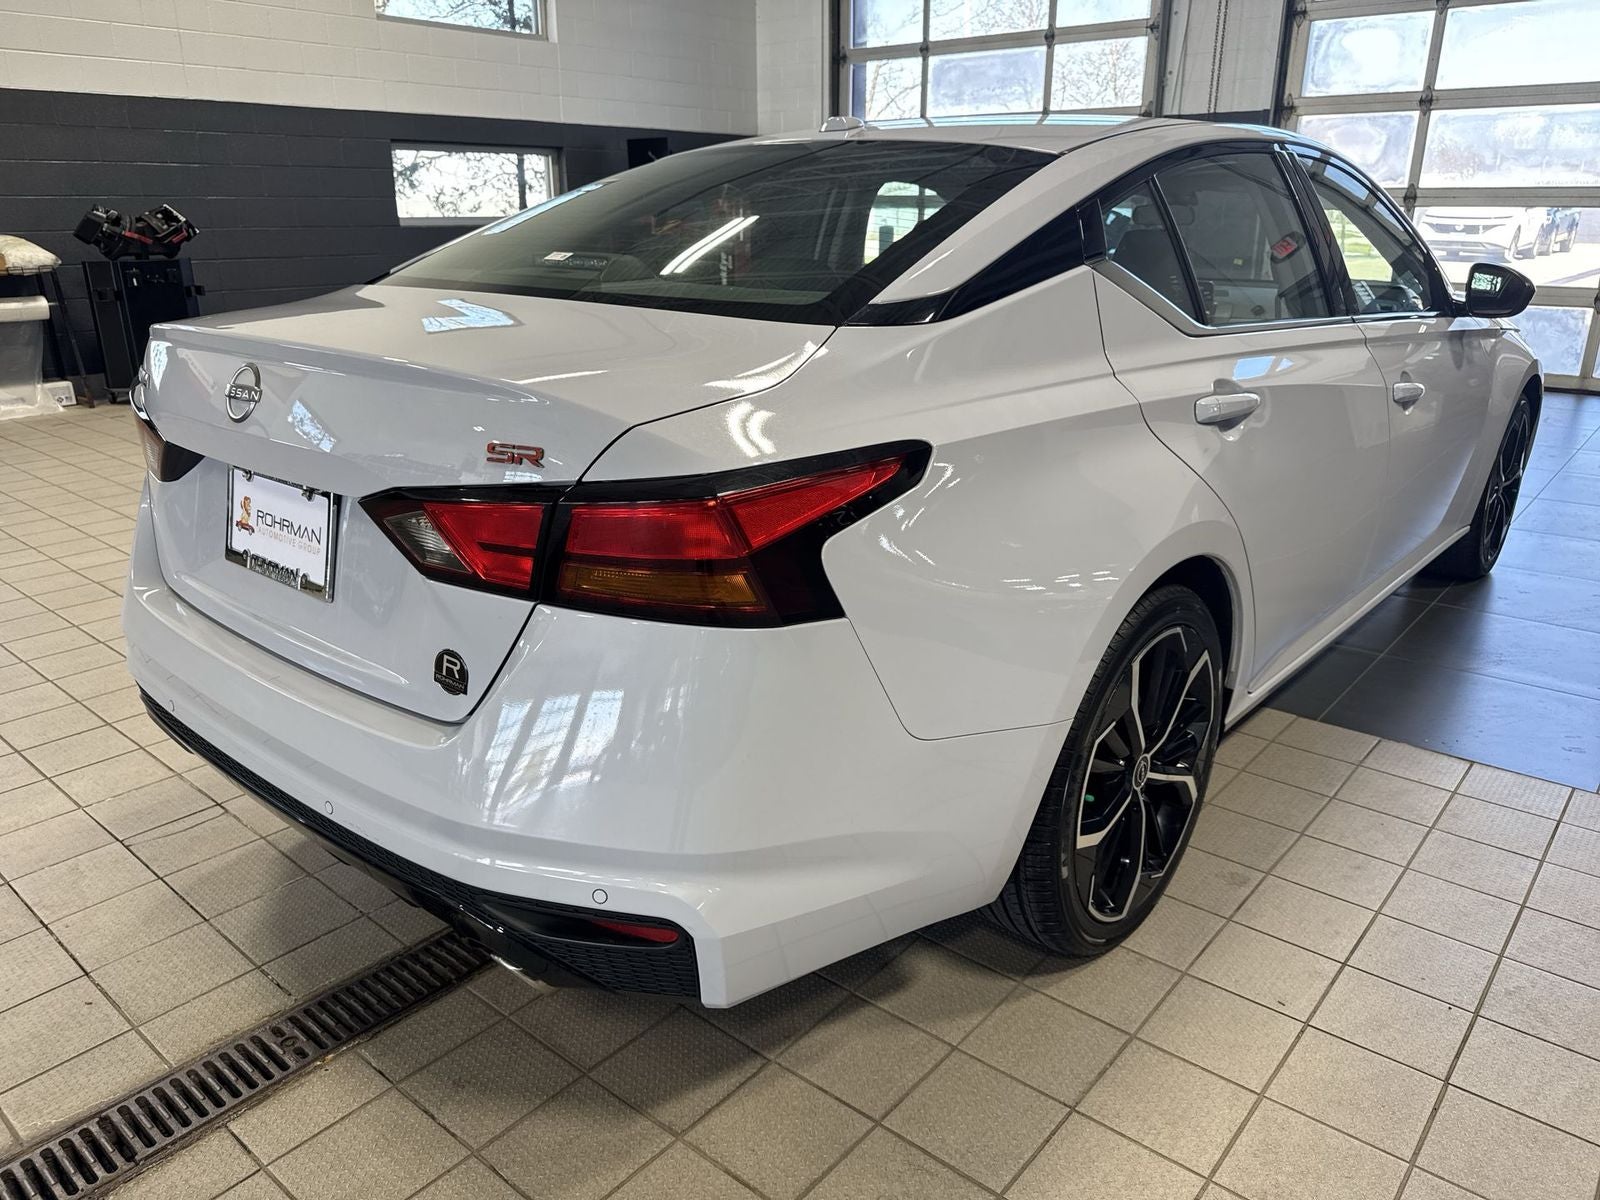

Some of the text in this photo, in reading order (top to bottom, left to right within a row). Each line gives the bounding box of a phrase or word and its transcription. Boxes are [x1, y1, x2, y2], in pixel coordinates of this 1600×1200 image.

[225, 386, 260, 401] SSAN
[487, 442, 545, 468] SR
[256, 509, 322, 545] ROHRMAN
[258, 526, 321, 555] AUTOMOTIVE GROUP
[443, 654, 460, 679] R
